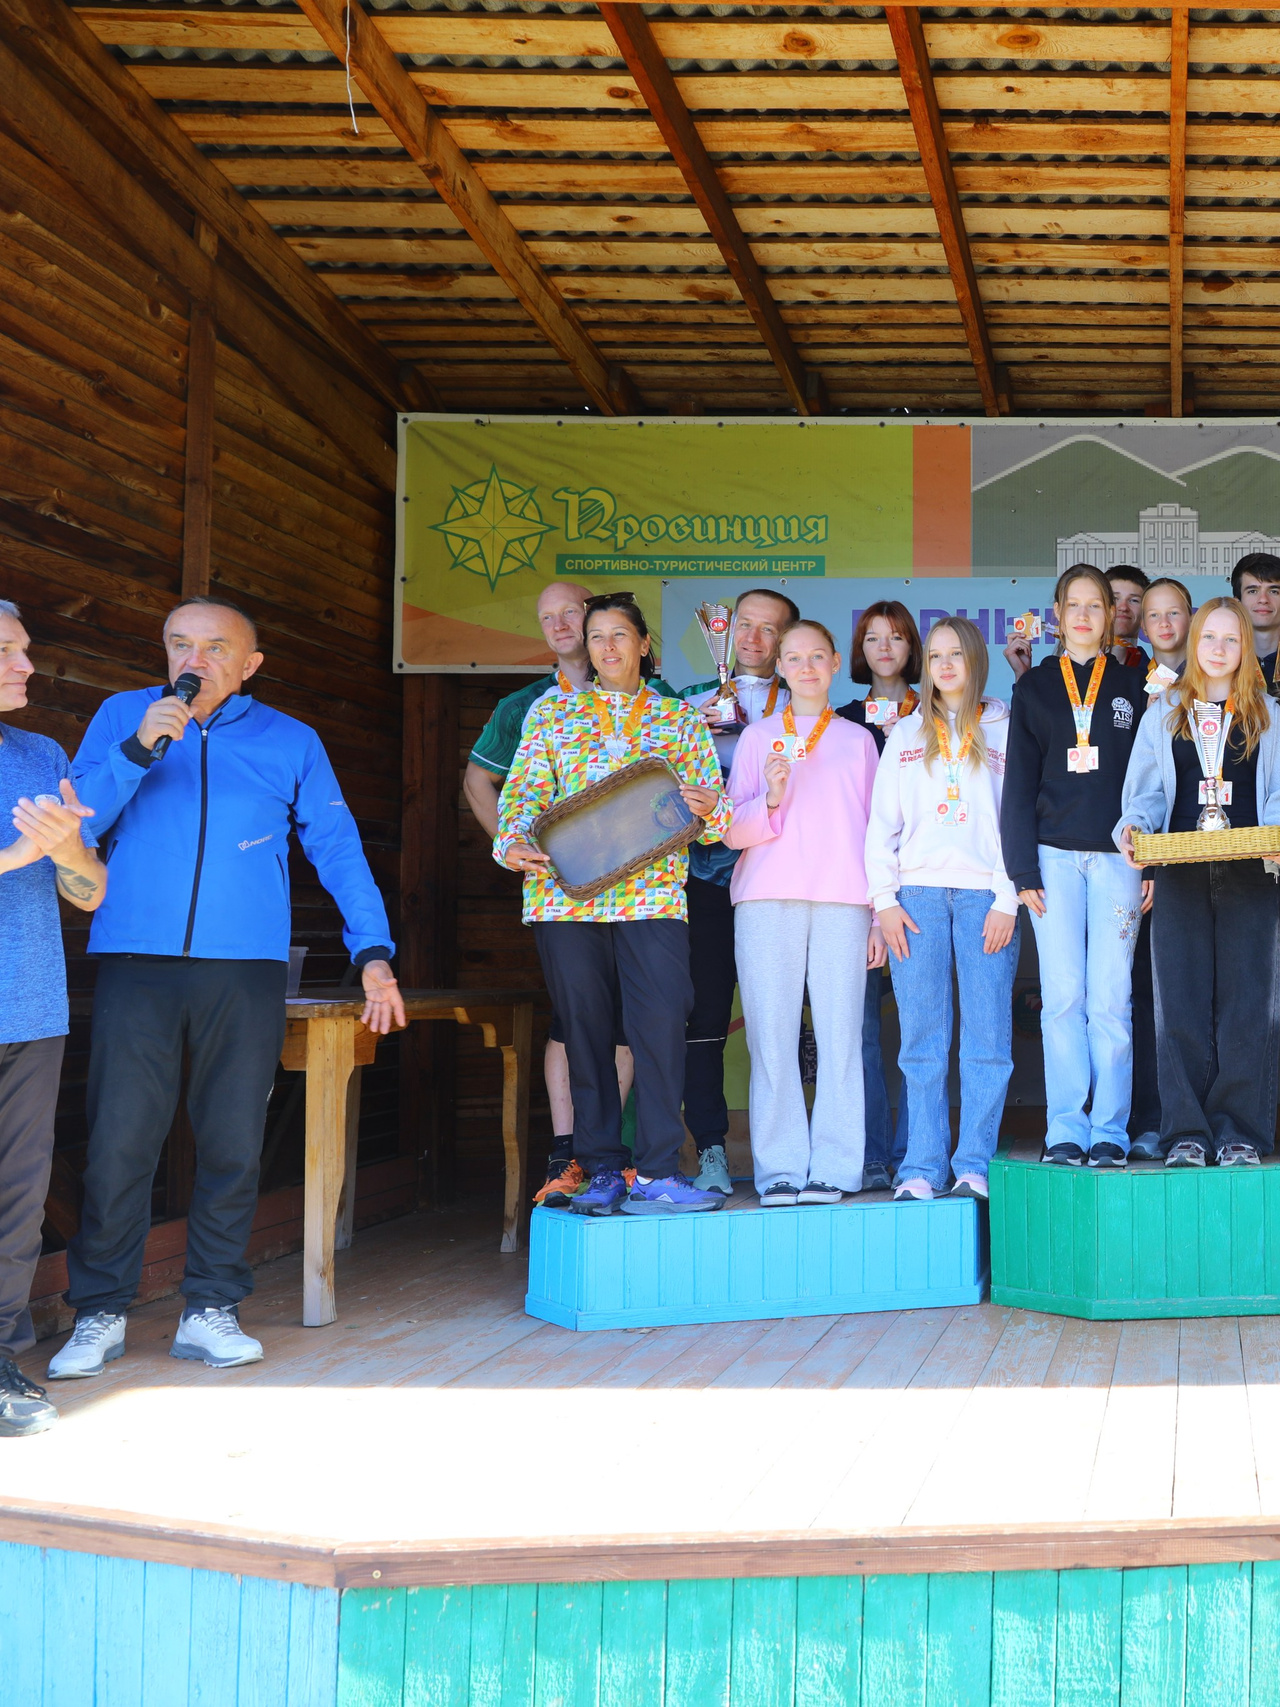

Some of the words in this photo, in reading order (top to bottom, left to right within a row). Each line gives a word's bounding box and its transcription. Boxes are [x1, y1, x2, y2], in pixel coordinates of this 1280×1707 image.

[564, 558, 769, 572] СПОРТИВНО-ТУРИСТИЧЕСКИЙ
[772, 560, 817, 573] ЦЕНТР
[797, 748, 805, 758] 2
[1223, 792, 1229, 802] 1
[958, 813, 967, 822] 2
